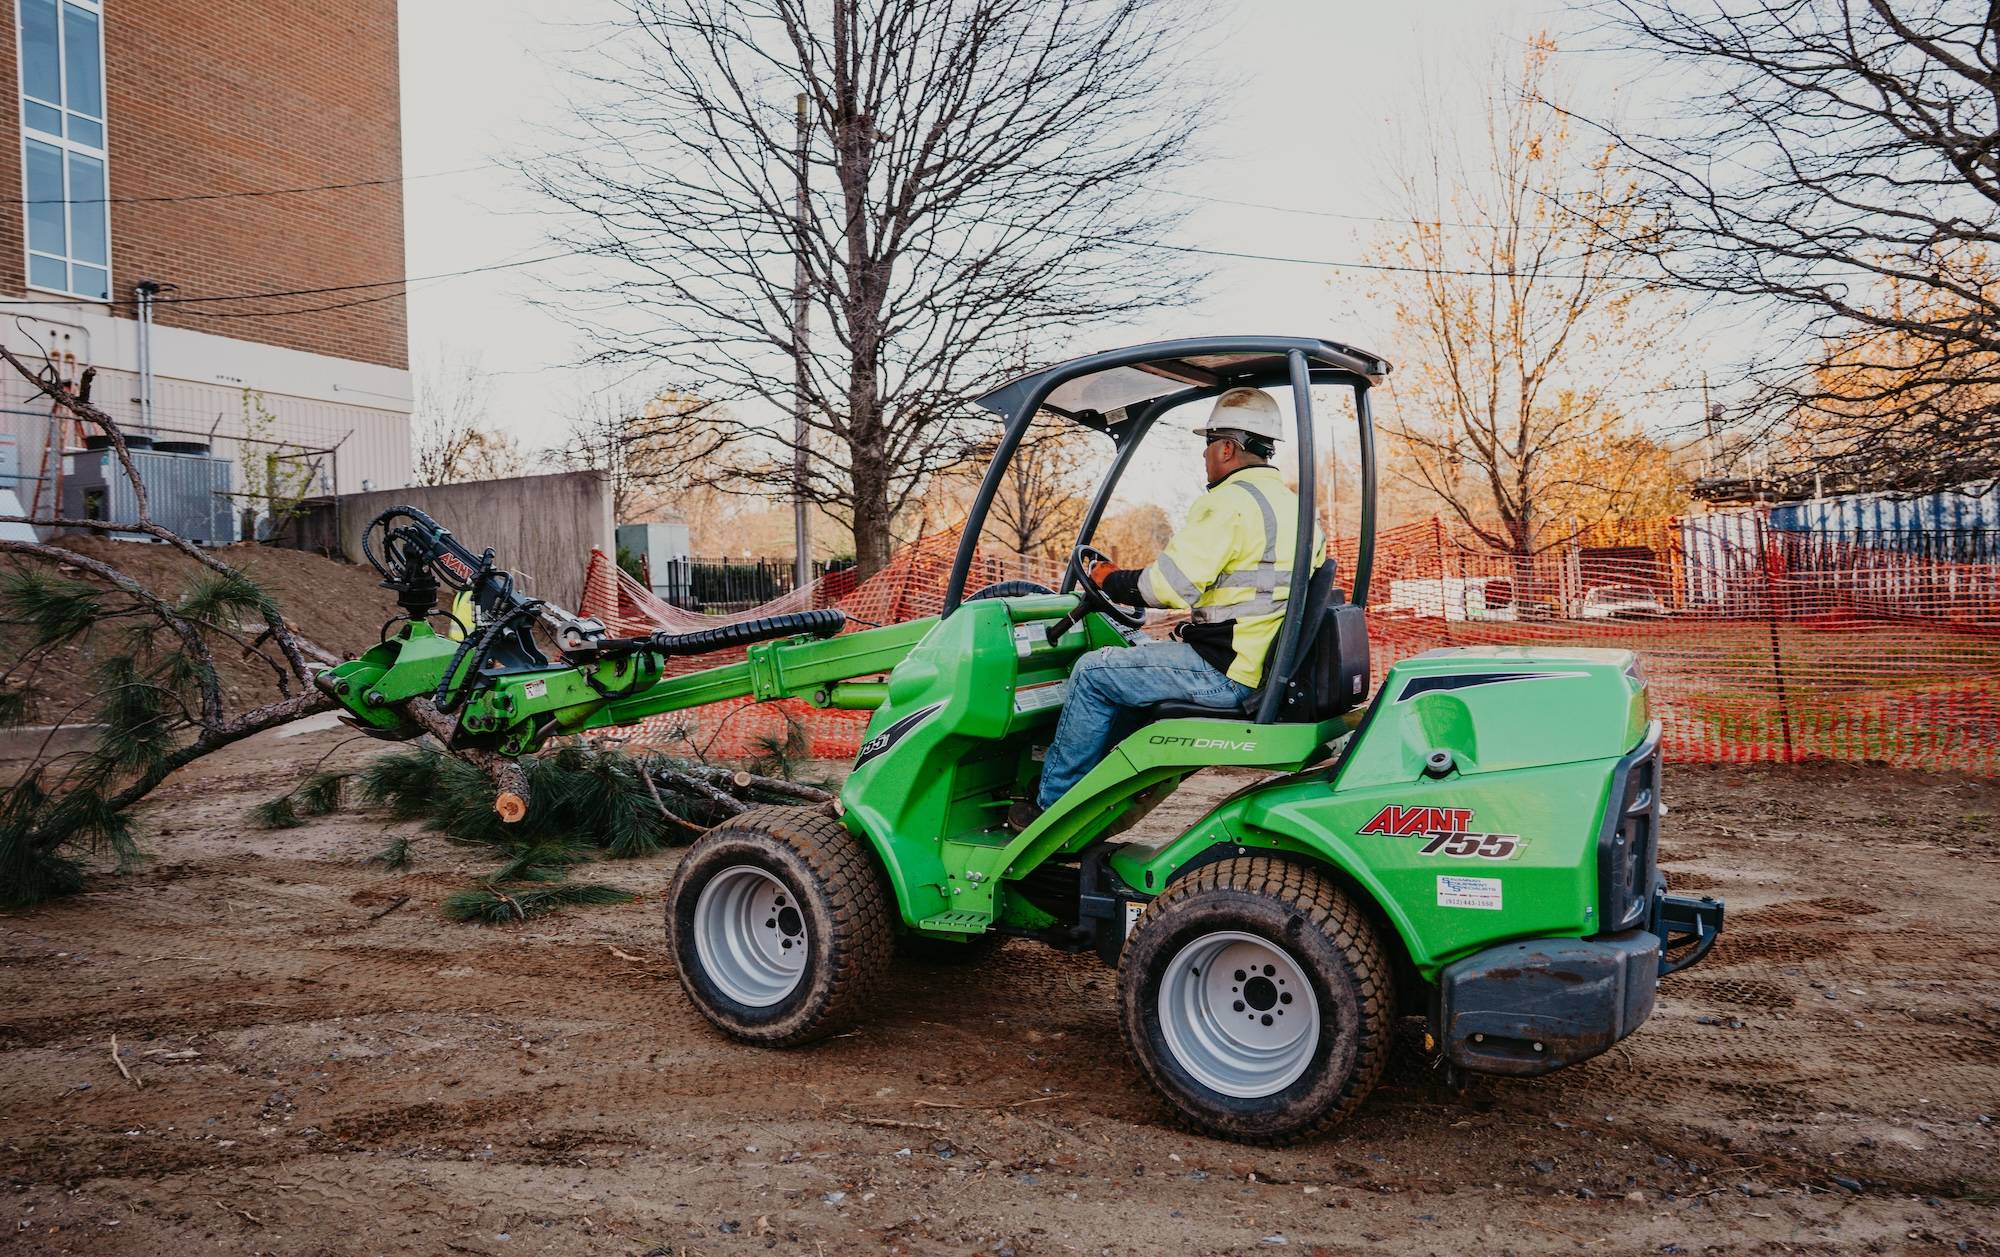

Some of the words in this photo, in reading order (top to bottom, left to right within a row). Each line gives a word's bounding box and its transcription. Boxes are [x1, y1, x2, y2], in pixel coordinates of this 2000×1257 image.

[438, 552, 475, 579] AVANT
[1149, 735, 1257, 752] OPTIDRIVE
[1359, 805, 1474, 837] AVANT
